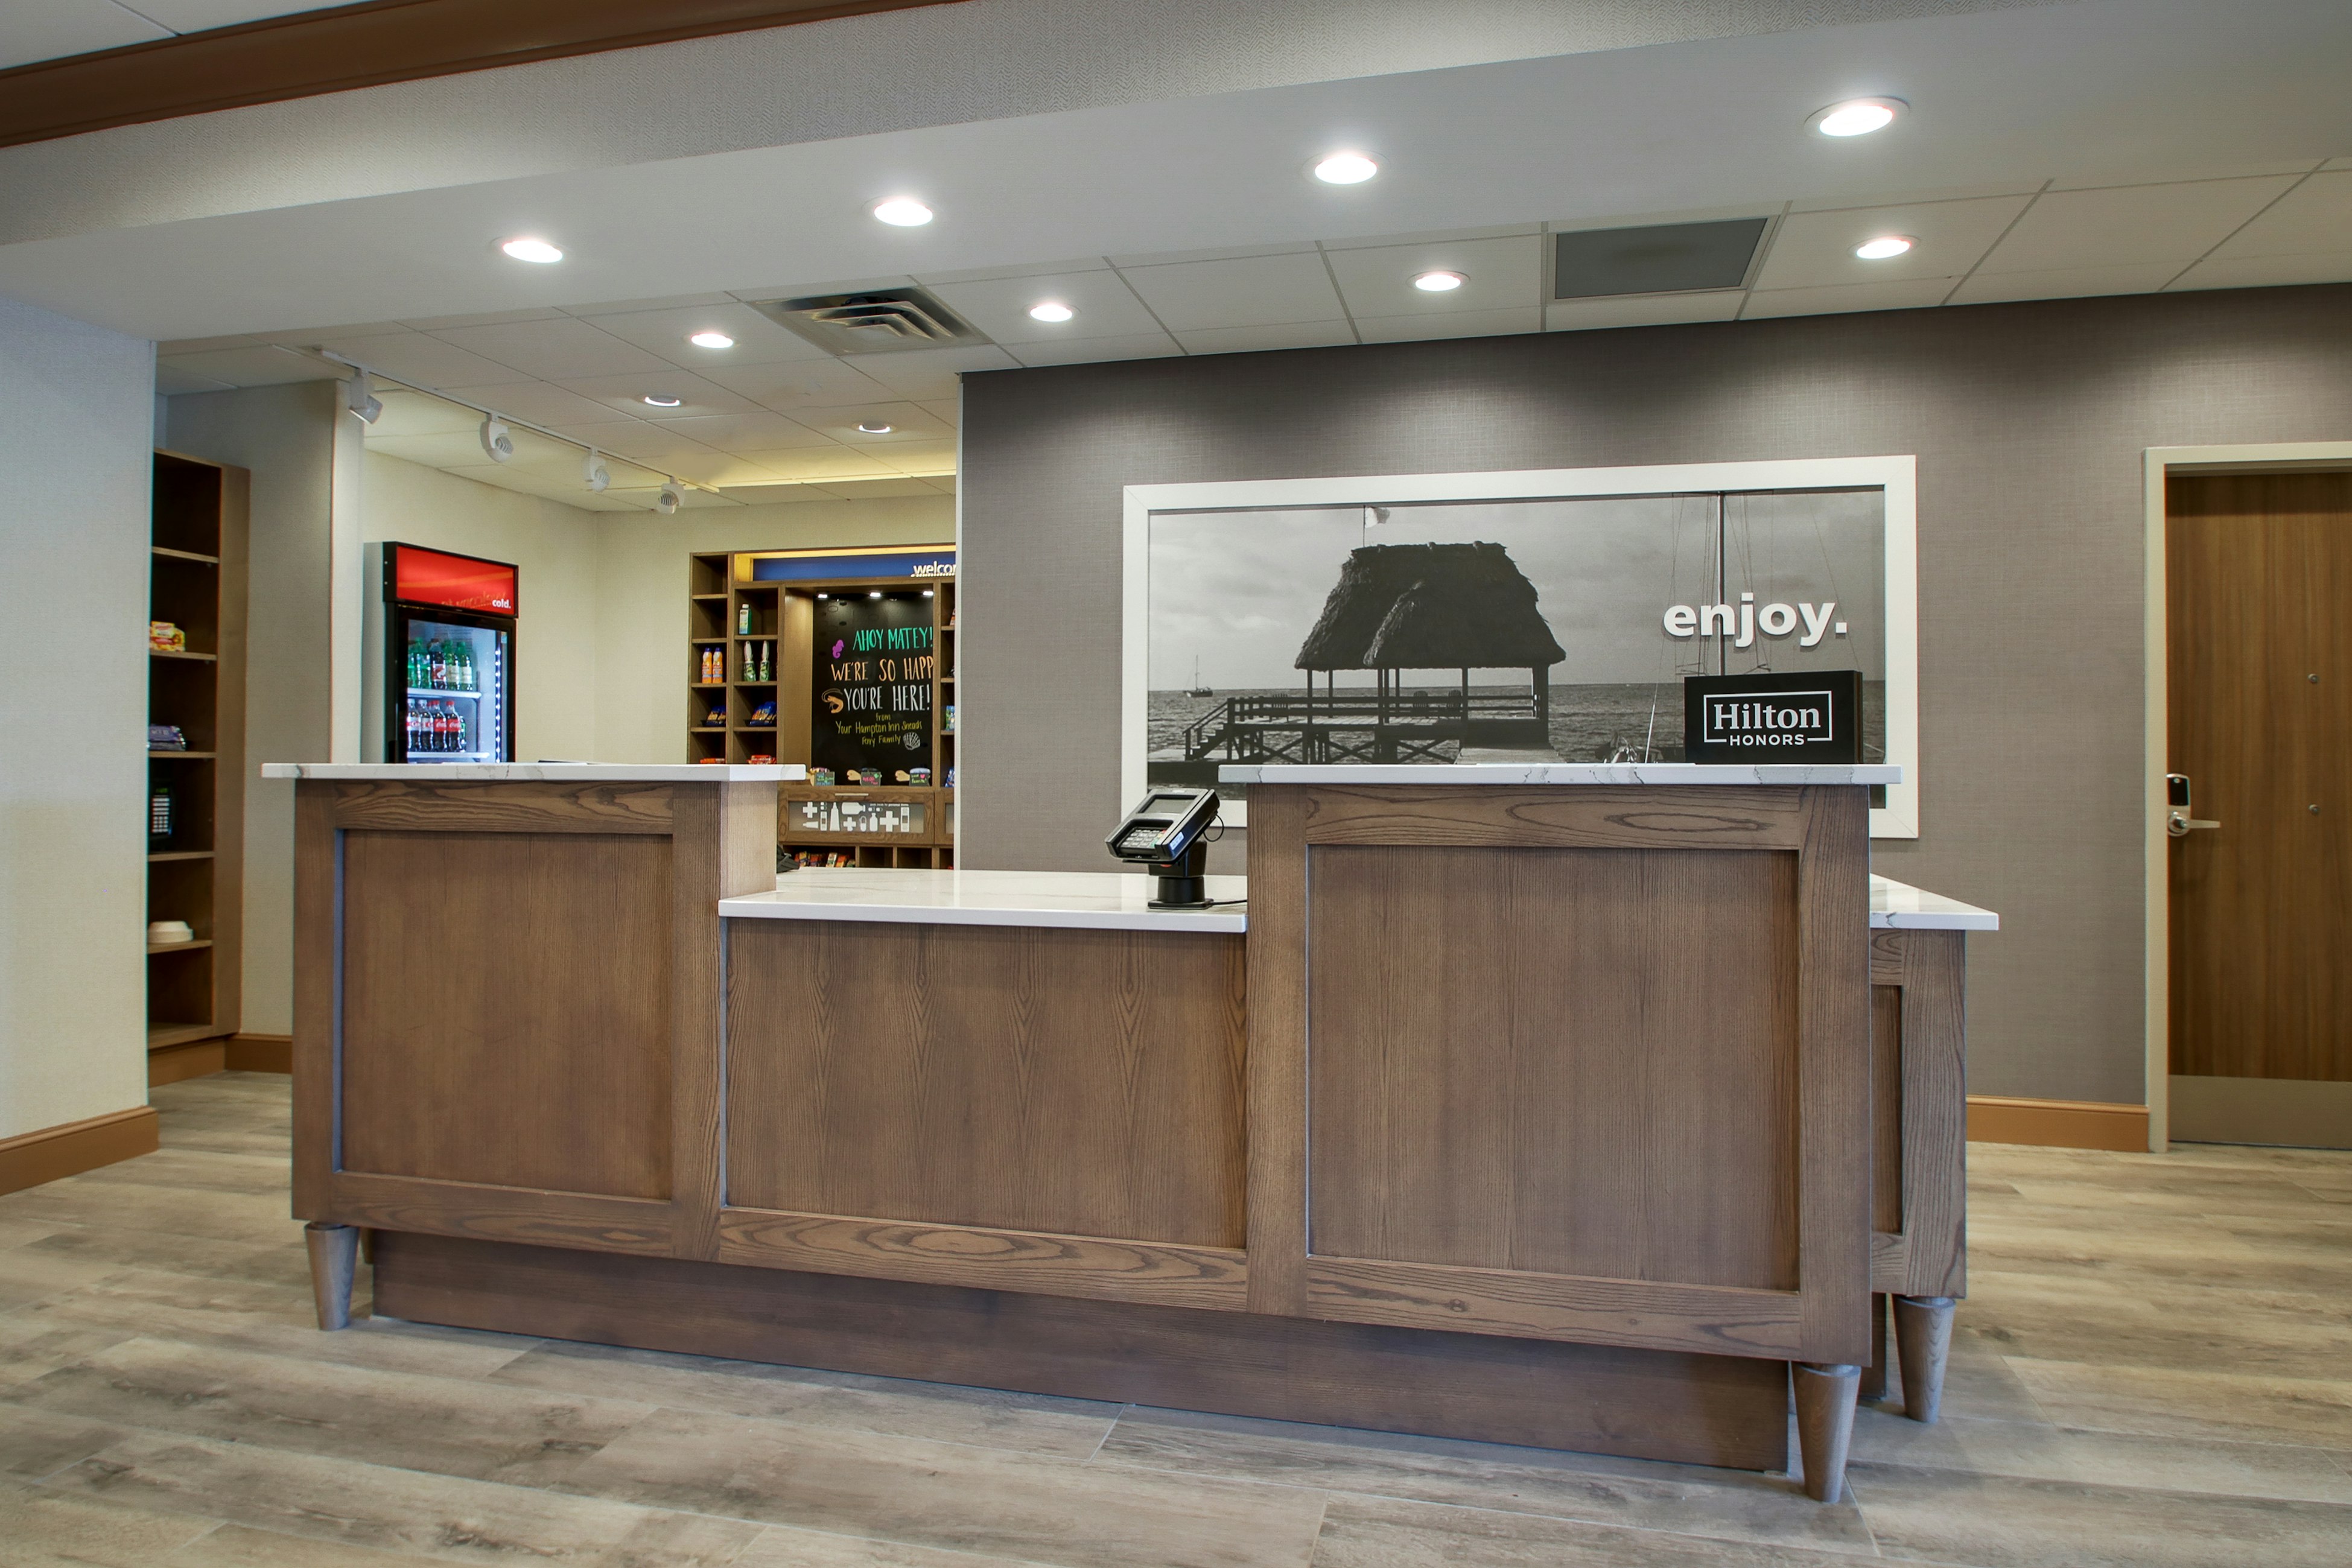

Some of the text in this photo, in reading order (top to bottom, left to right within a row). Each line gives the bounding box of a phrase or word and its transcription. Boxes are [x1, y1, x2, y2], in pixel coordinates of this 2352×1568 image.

[492, 598, 512, 609] cold.
[1663, 592, 1848, 648] enjoy.
[853, 626, 933, 652] AHOY MATEY!
[830, 661, 869, 682] WE'RE
[879, 658, 897, 682] SO
[844, 684, 930, 712] YOU'RE HERE!
[876, 713, 891, 722] from
[1714, 703, 1821, 730] Hilton
[835, 720, 852, 734] Your
[855, 720, 887, 737] Hampton
[888, 722, 900, 732] Inn
[878, 734, 901, 745] Family
[1729, 734, 1805, 746] HONORS
